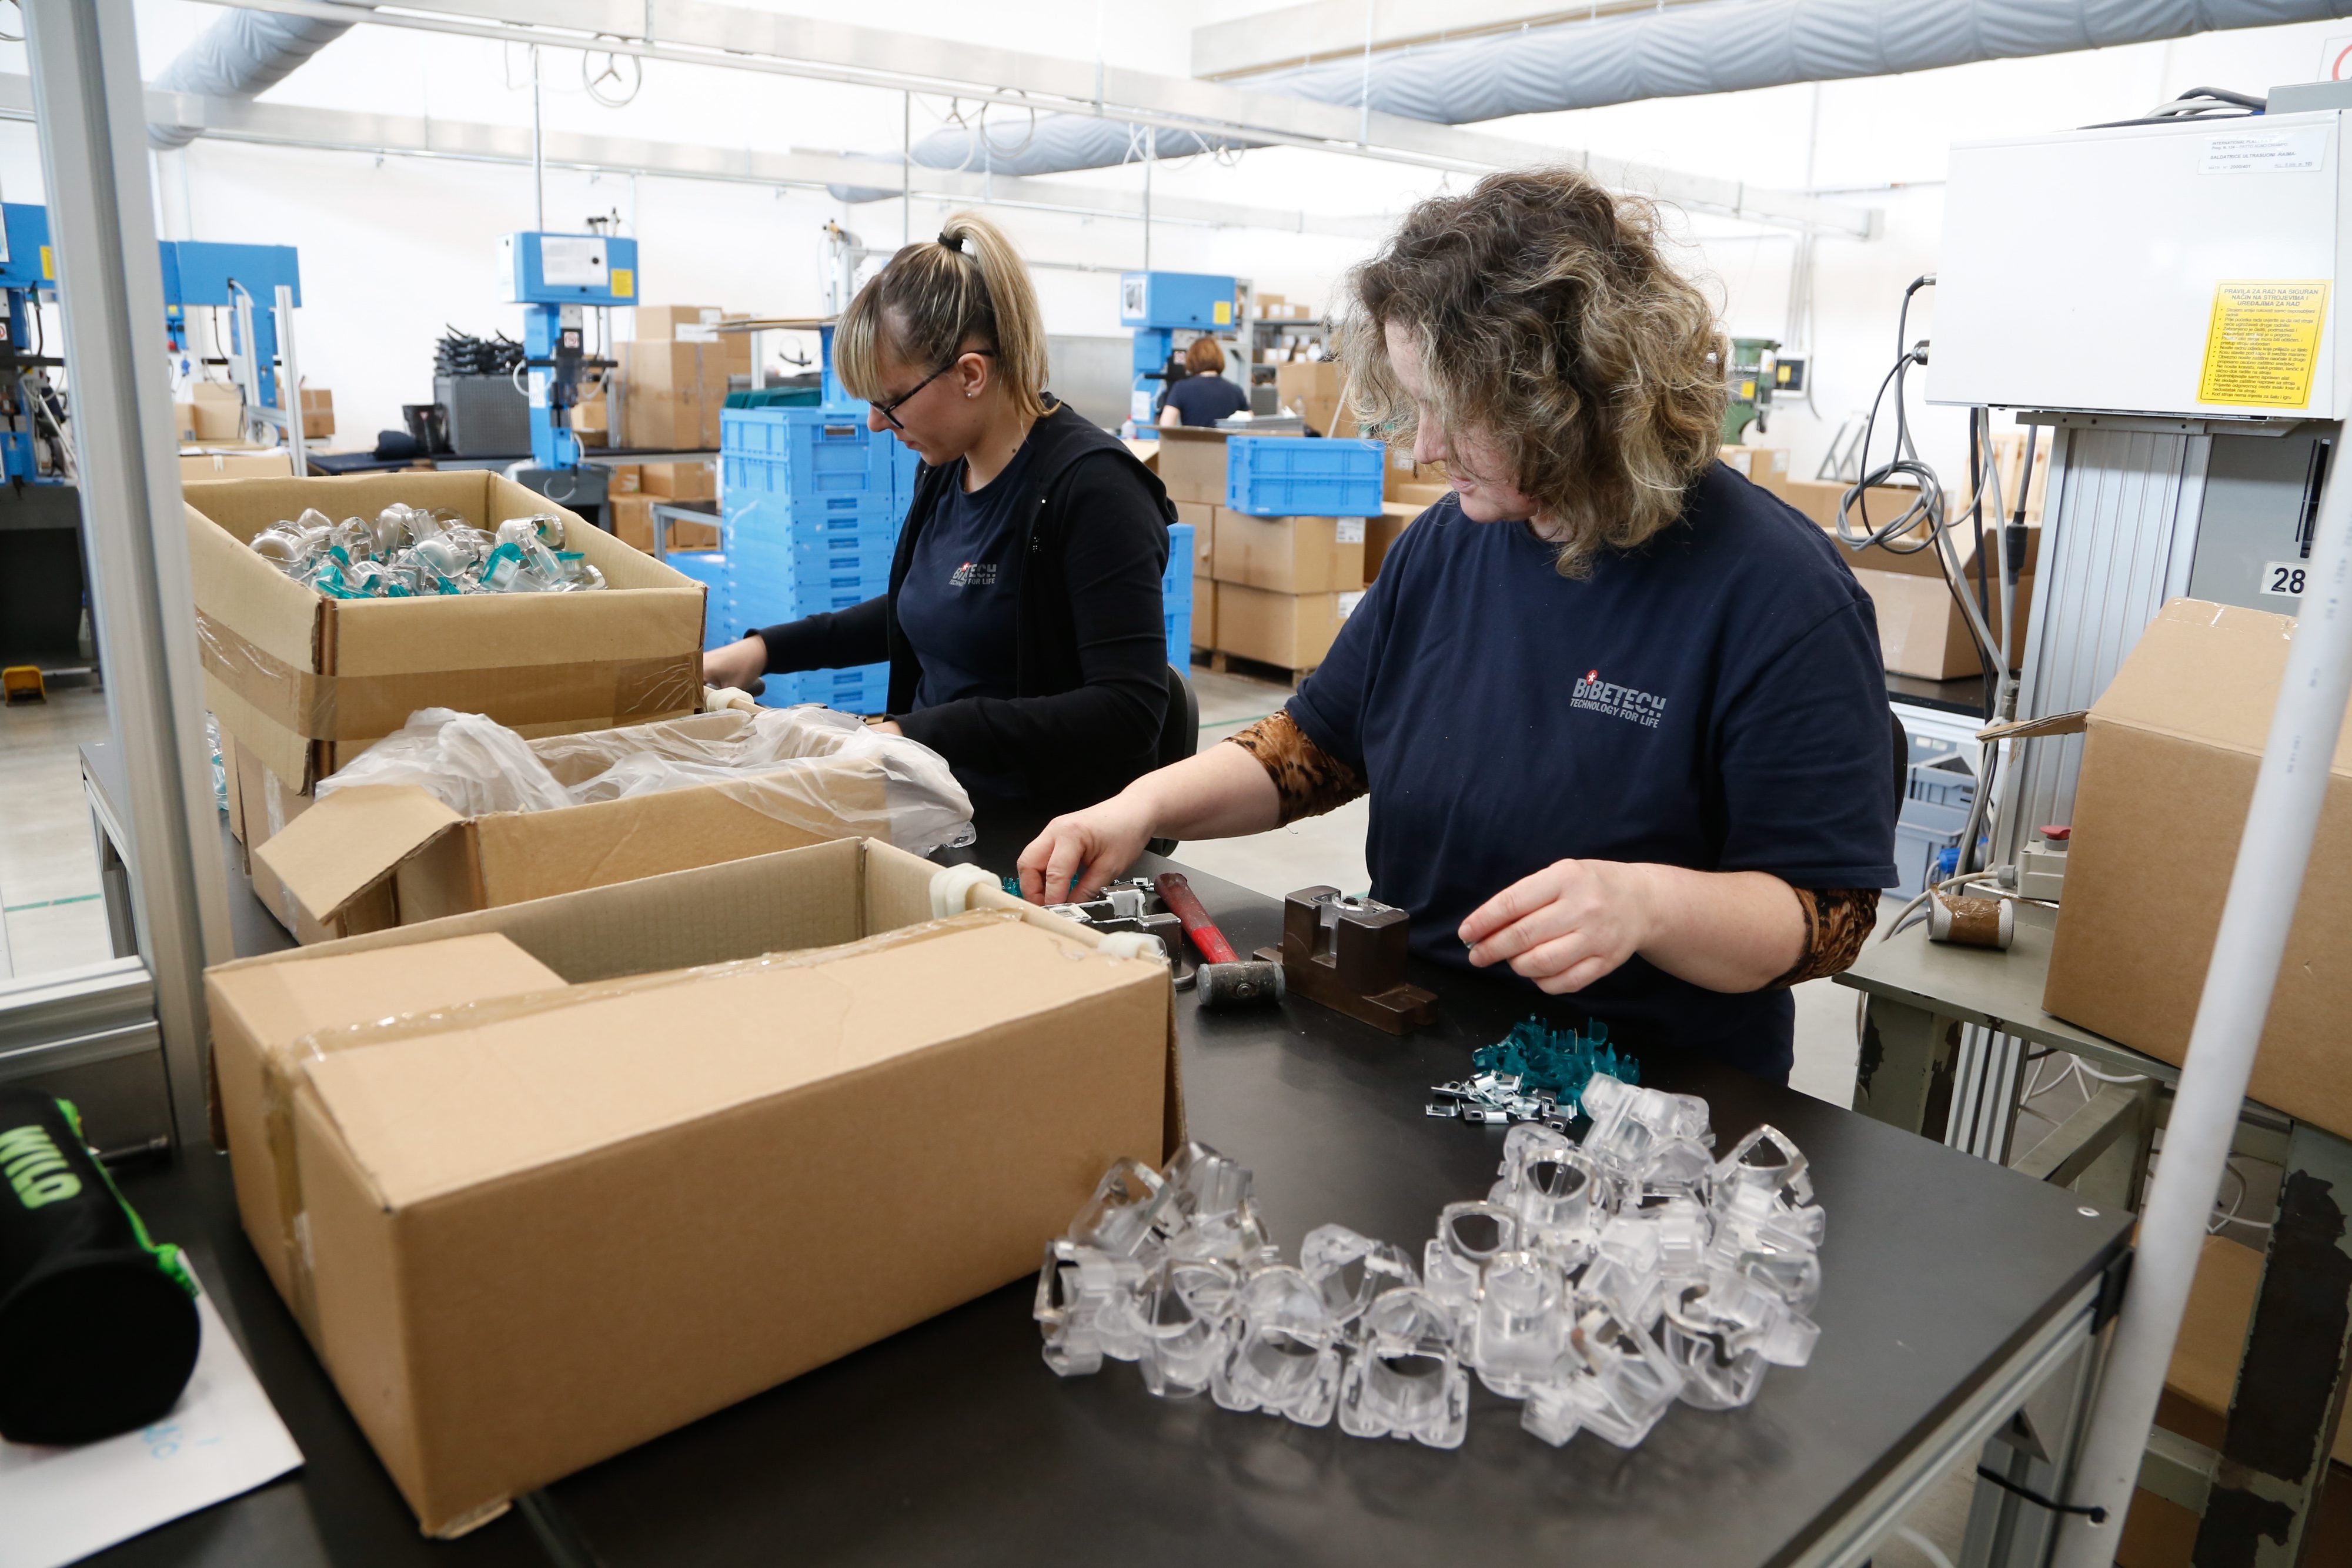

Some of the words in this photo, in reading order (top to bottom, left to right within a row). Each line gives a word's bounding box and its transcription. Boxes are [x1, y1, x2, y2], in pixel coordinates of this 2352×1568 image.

[2271, 567, 2306, 594] 28
[1570, 698, 1619, 716] TECHNOLOGY
[1619, 709, 1639, 722] FOR
[1639, 715, 1659, 728] LIFE
